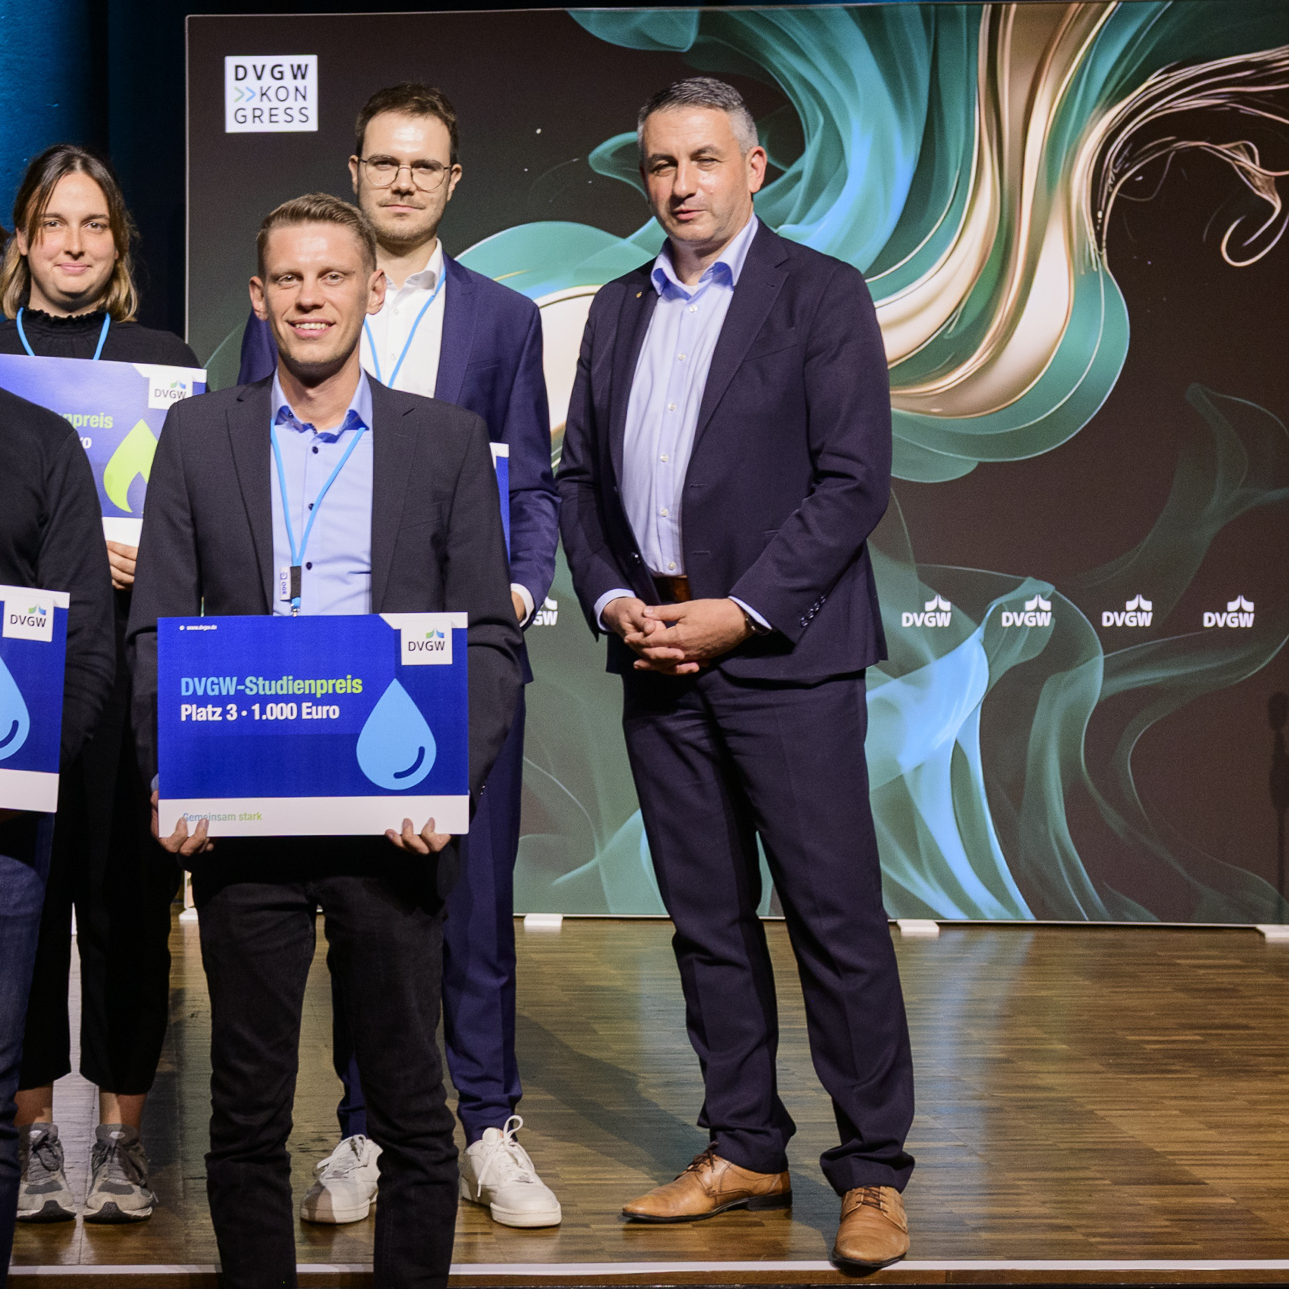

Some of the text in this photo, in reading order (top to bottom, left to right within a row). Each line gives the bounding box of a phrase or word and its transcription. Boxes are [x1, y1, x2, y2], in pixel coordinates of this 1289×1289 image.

[234, 64, 309, 81] DVGW
[260, 86, 307, 102] KON
[234, 107, 309, 124] GRESS
[154, 388, 186, 399] DVGW
[10, 614, 46, 628] DVGW
[532, 610, 558, 626] GW
[901, 612, 952, 627] DVGW
[1001, 611, 1052, 627] DVGW
[1101, 611, 1153, 627] DVGW
[1203, 612, 1255, 628] DVGW
[408, 640, 445, 651] DVGW
[180, 675, 363, 698] DVGW-Studienpreis
[180, 702, 340, 721] Platz 3 1.000 Euro
[239, 811, 263, 821] stark
